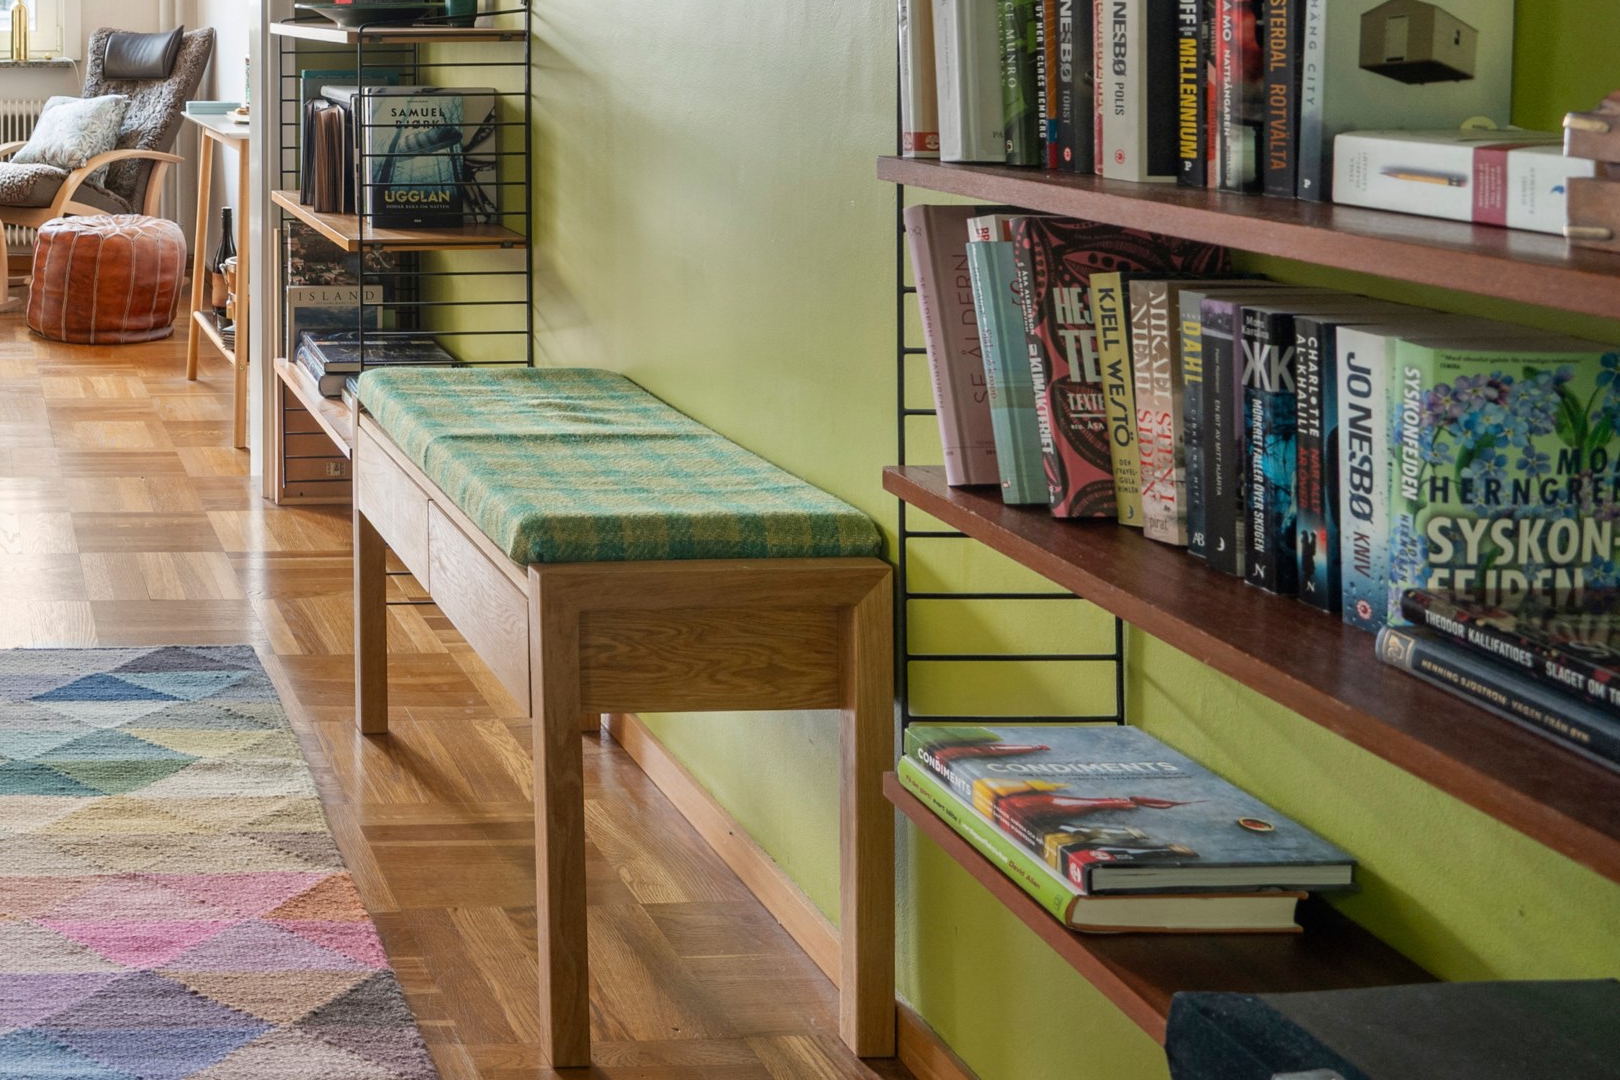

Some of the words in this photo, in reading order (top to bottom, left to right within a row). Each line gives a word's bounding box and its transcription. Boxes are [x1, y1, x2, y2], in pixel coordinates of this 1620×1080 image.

[1036, 5, 1044, 18] UT
[1222, 16, 1232, 41] MO
[1036, 22, 1044, 43] MER
[1112, 1, 1127, 77] NESBØ
[1005, 29, 1017, 88] MUNRO
[1037, 56, 1045, 88] CLAES
[1115, 82, 1125, 116] POLIS
[1179, 38, 1197, 159] MILLENNIUM
[1223, 49, 1233, 136] NATTSÅNGAREN
[1305, 63, 1317, 106] CITY
[391, 107, 445, 117] SAMUEL
[1038, 92, 1047, 139] HEMBERG
[1062, 90, 1070, 124] TÖRST
[1269, 84, 1288, 169] ROTVÄLTA
[384, 190, 451, 203] UGGLAN
[298, 291, 375, 301] ISLAND
[1023, 288, 1035, 336] ALBINSSON
[1097, 287, 1120, 352] KJELL
[1131, 302, 1151, 390] NIEMI
[1149, 290, 1173, 402] MIKAEL
[1182, 320, 1203, 386] DAHL
[1296, 333, 1308, 434] AL-KHALILI
[1346, 351, 1372, 399] JO
[1030, 356, 1055, 455] KLIMAKTERIET
[1106, 359, 1134, 448] WESTÖ
[1214, 399, 1221, 412] EN
[1252, 399, 1263, 446] MÖRKRET
[1087, 420, 1105, 430] ÅSA
[1214, 429, 1221, 440] AV
[1401, 366, 1421, 501] SYSKONFEJDEN
[1214, 441, 1222, 461] MITT
[1253, 447, 1264, 483] FALLER
[1348, 402, 1374, 525] NESBØ
[1556, 447, 1620, 475] MO
[1117, 486, 1139, 494] HIMLEN
[1119, 477, 1136, 485] GULA
[1214, 463, 1222, 496] HJÄRTA
[1253, 484, 1265, 510] ÖVER
[1149, 516, 1169, 531] pirat
[1192, 533, 1205, 547] AB
[1254, 511, 1265, 553] SKOGEN
[1427, 515, 1620, 566] SYSKON-
[1353, 530, 1371, 578] KNIV
[1421, 658, 1460, 684] HENNING
[1425, 608, 1466, 638] THEODOR
[1468, 628, 1534, 668] KALLIFATIDES
[1545, 660, 1585, 690] SLAGET
[1588, 678, 1606, 698] OM
[918, 747, 972, 797] CONDIMENTS
[986, 761, 1179, 774] CONDIMENTS
[1008, 860, 1025, 878] David
[1026, 874, 1041, 890] Allen
